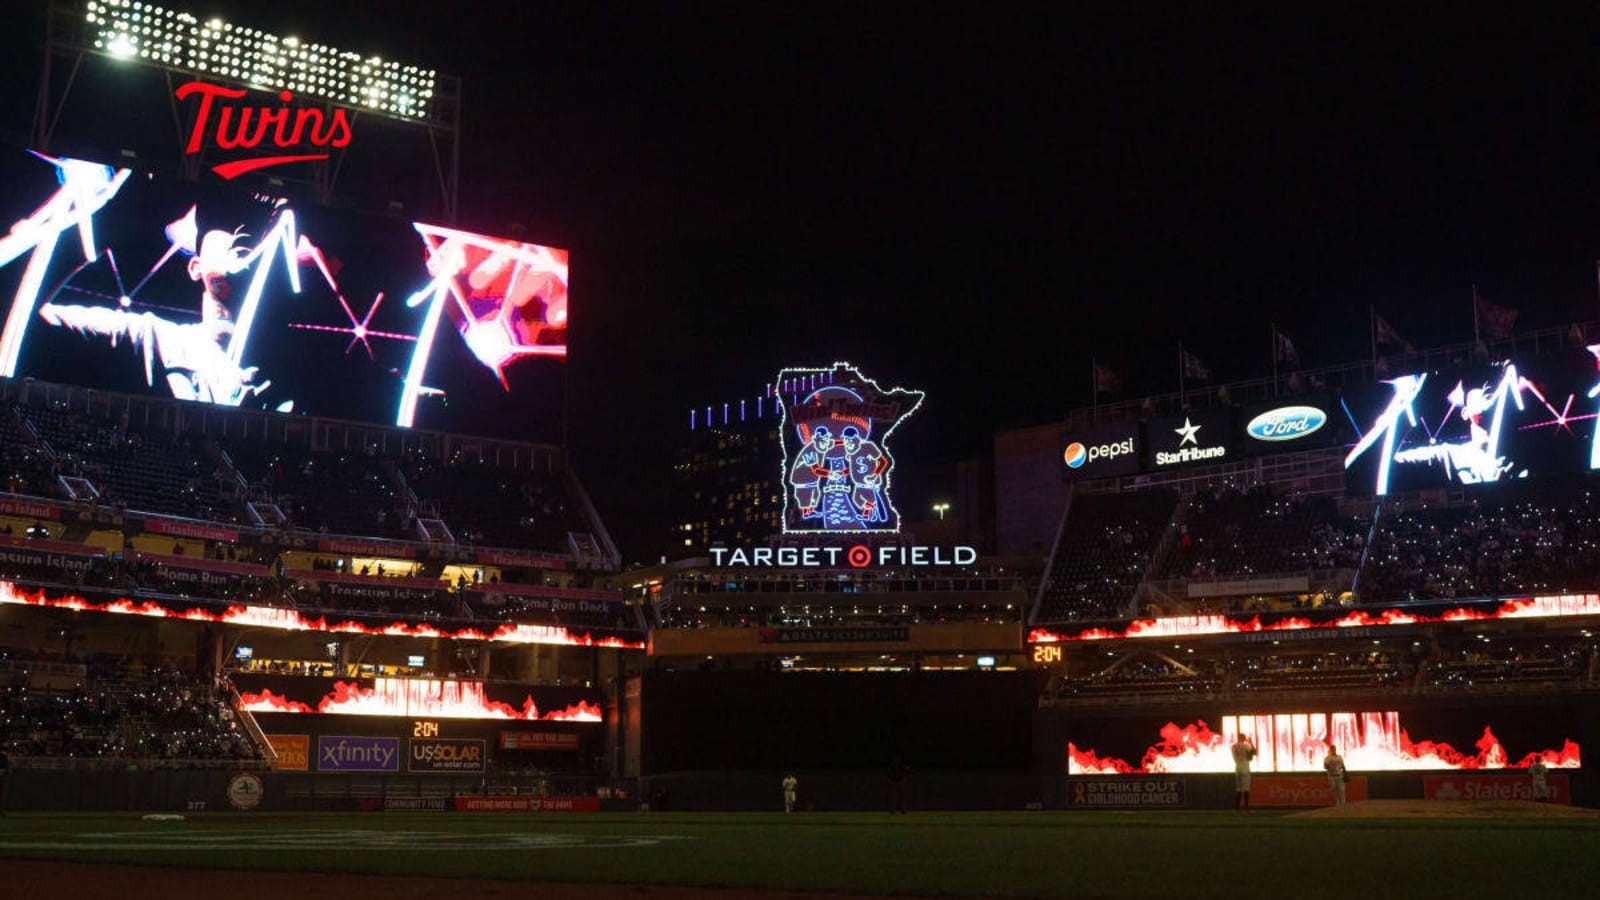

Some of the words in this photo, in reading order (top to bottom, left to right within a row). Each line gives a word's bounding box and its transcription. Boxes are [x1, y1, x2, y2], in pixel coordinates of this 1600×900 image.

[175, 81, 352, 155] Twins
[1262, 416, 1309, 436] Ford
[1088, 437, 1134, 463] pepsi
[1156, 445, 1226, 466] StarTribune
[708, 547, 843, 567] TARGET
[879, 546, 977, 566] FIELD
[1034, 645, 1062, 662] 2:04
[413, 721, 439, 737] 2:04
[323, 740, 395, 768] xfinity
[1088, 782, 1142, 793] STRIKE
[1144, 782, 1178, 793] OUT
